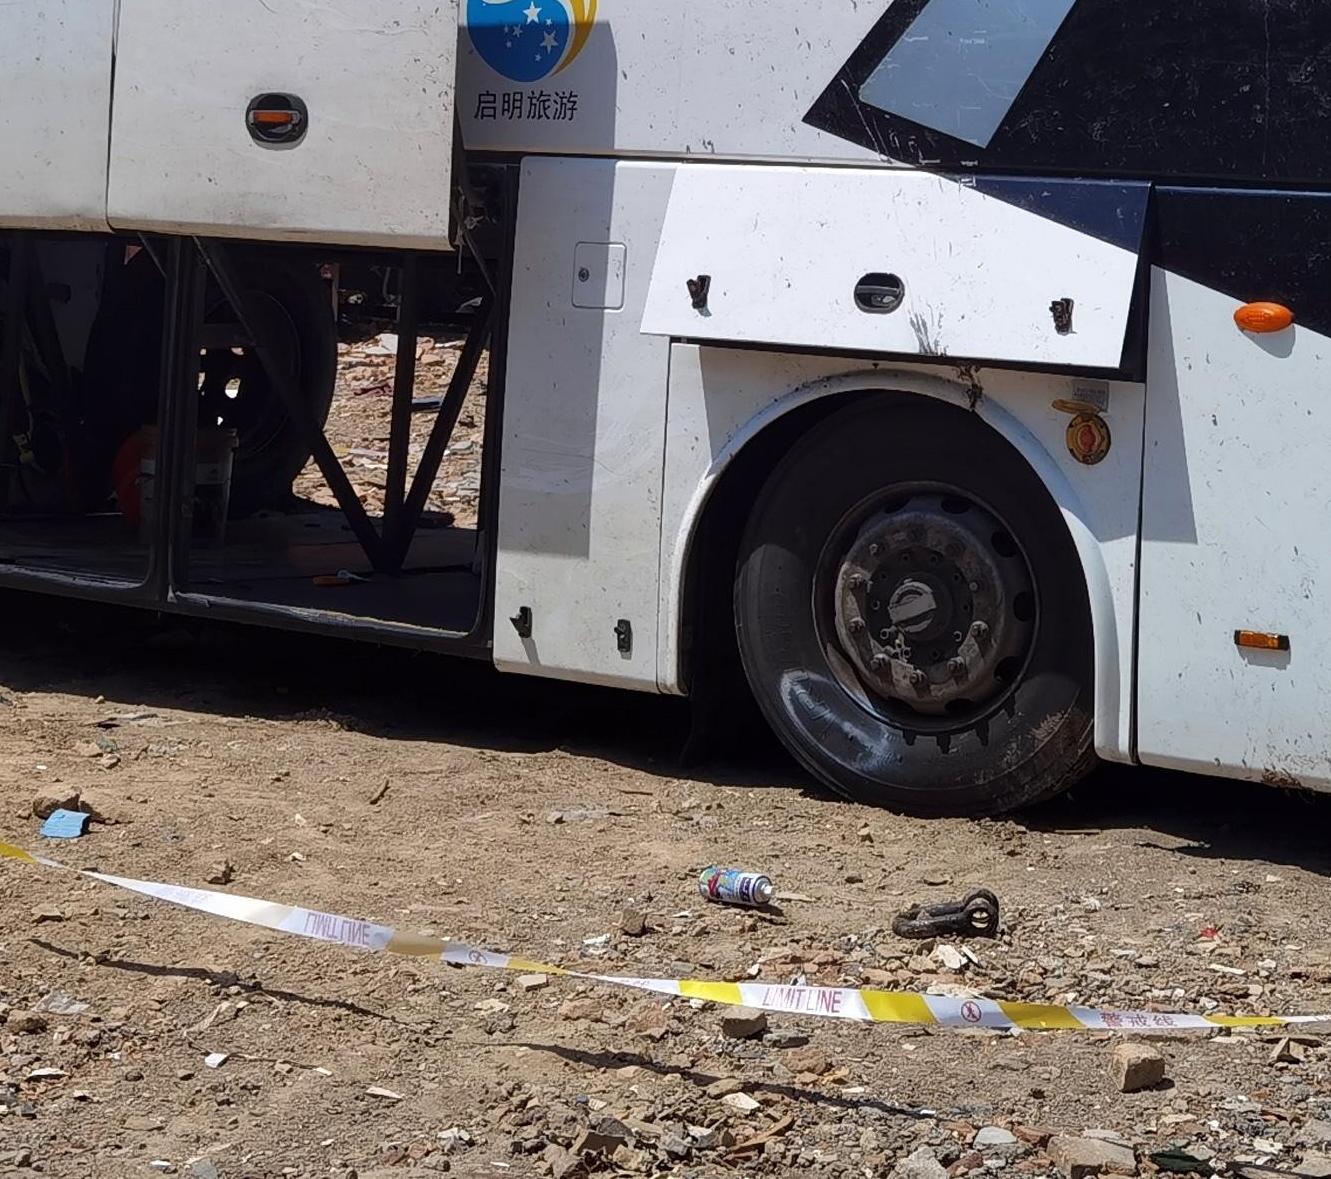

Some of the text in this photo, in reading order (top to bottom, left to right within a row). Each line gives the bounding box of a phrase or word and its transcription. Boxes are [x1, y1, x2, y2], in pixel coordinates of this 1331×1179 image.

[474, 89, 579, 121] 启明旅游
[762, 986, 842, 1013] LIMIT LINE
